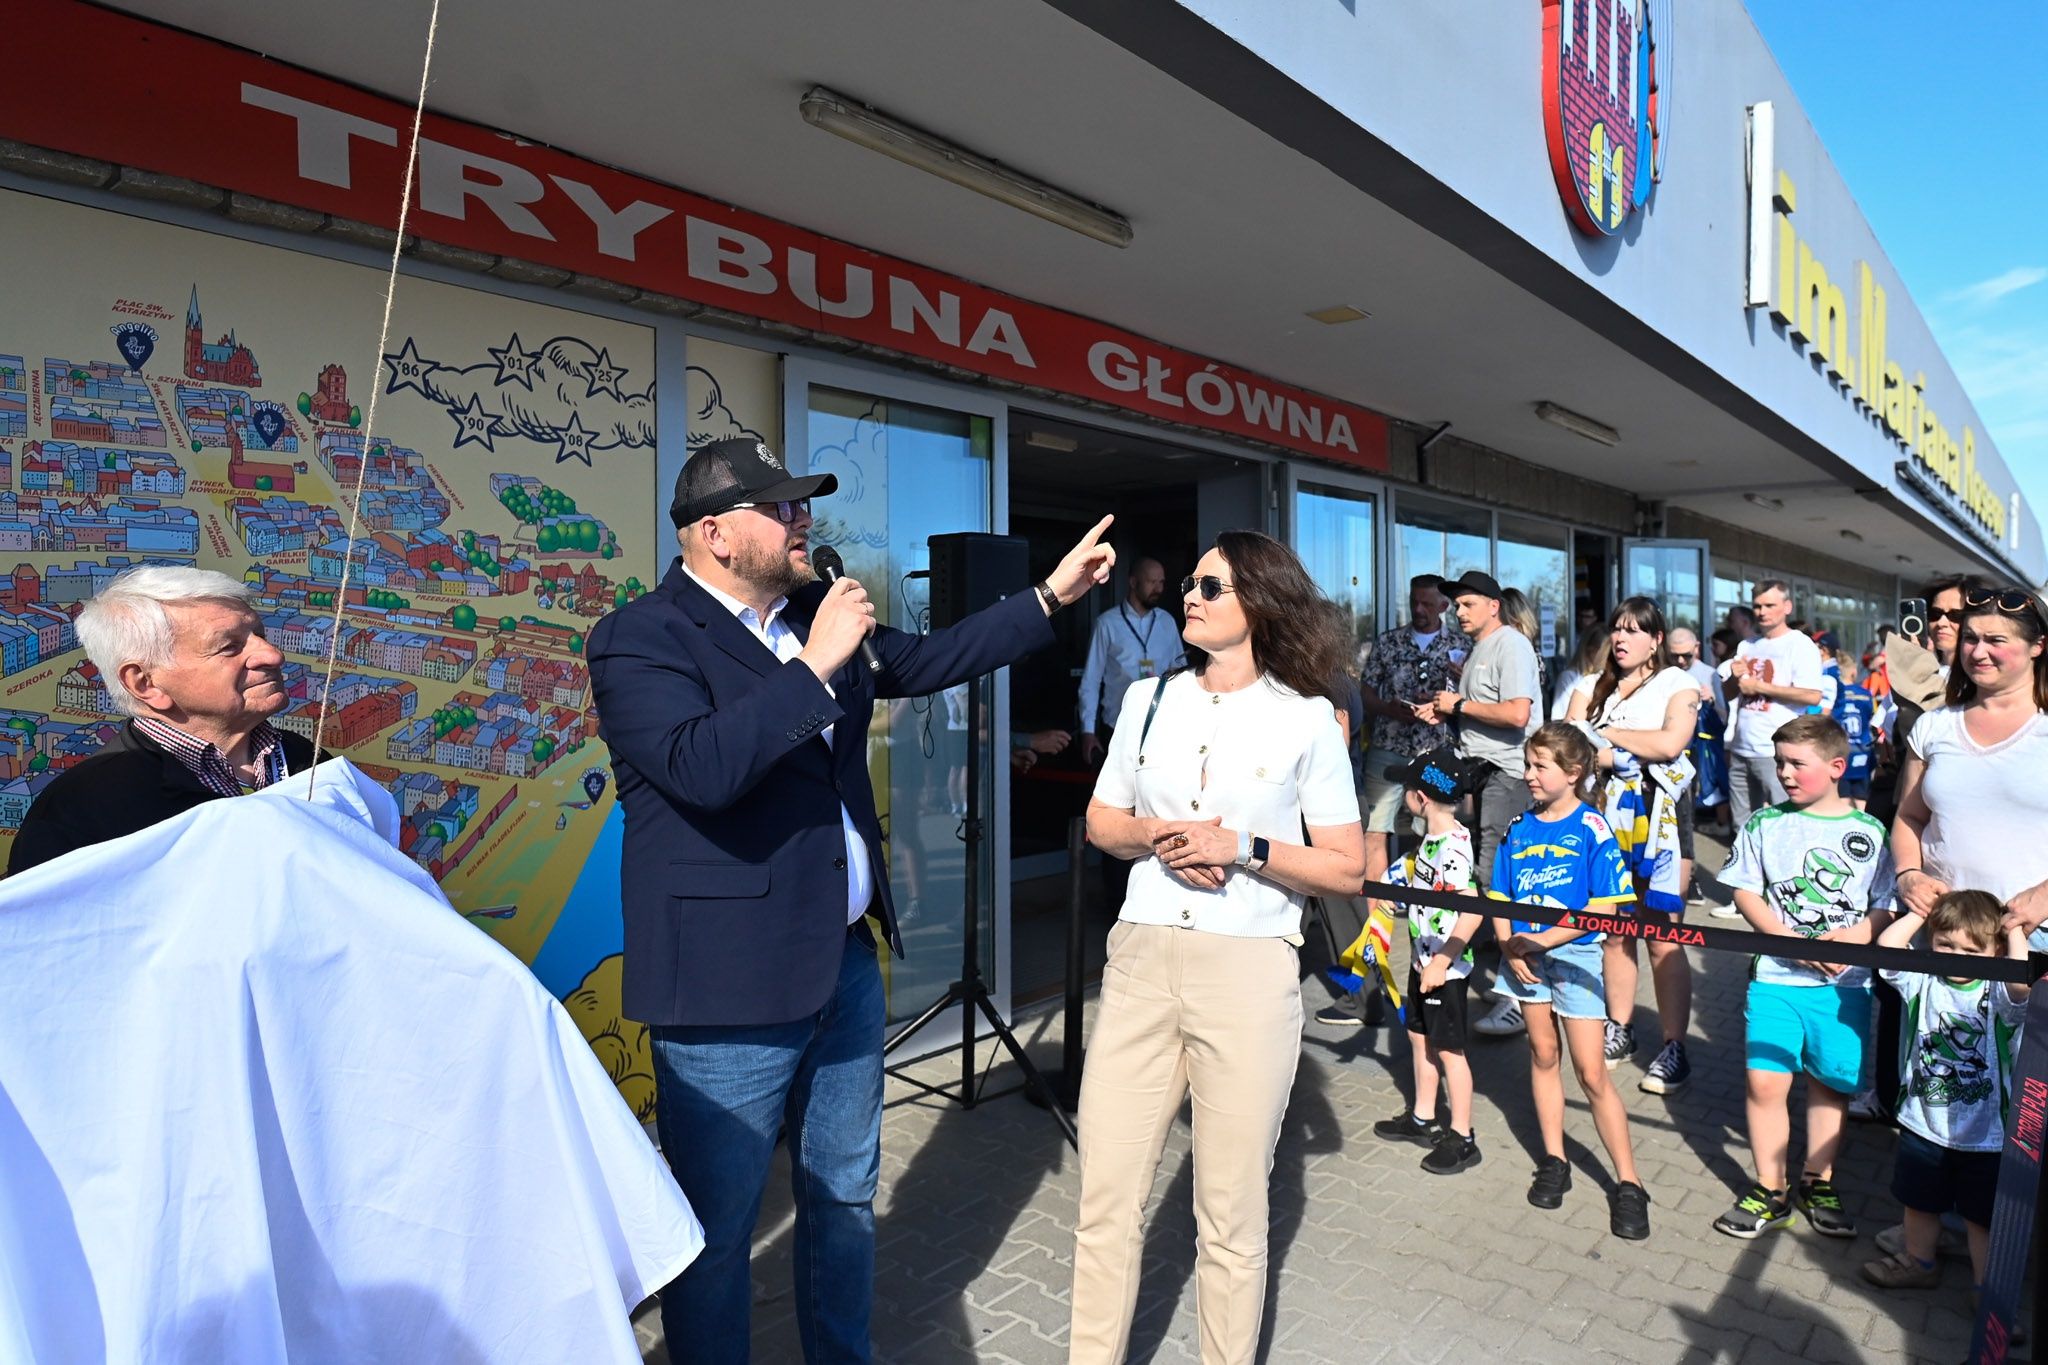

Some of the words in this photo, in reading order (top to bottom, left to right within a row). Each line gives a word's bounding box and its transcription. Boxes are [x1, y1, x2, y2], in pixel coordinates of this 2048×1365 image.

[241, 81, 1036, 368] TRYBUNA
[1087, 341, 1359, 453] GŁÓWNA
[115, 298, 143, 308] PLAC
[112, 305, 175, 321] KATARZYNY
[110, 322, 159, 342] Angelito
[397, 360, 420, 377] '86
[502, 355, 524, 371] '01
[157, 375, 205, 388] SZUMANA
[463, 415, 485, 431] '90
[564, 432, 584, 447] '08
[191, 479, 225, 488] RYNEK
[188, 486, 257, 498] NOWOMIEJSKI
[204, 524, 226, 559] JADWIGI
[266, 558, 307, 566] GARBARY
[6, 668, 54, 696] SZEROKA
[1577, 915, 1639, 937] TORUŃ
[1643, 924, 1706, 945] PLAZA
